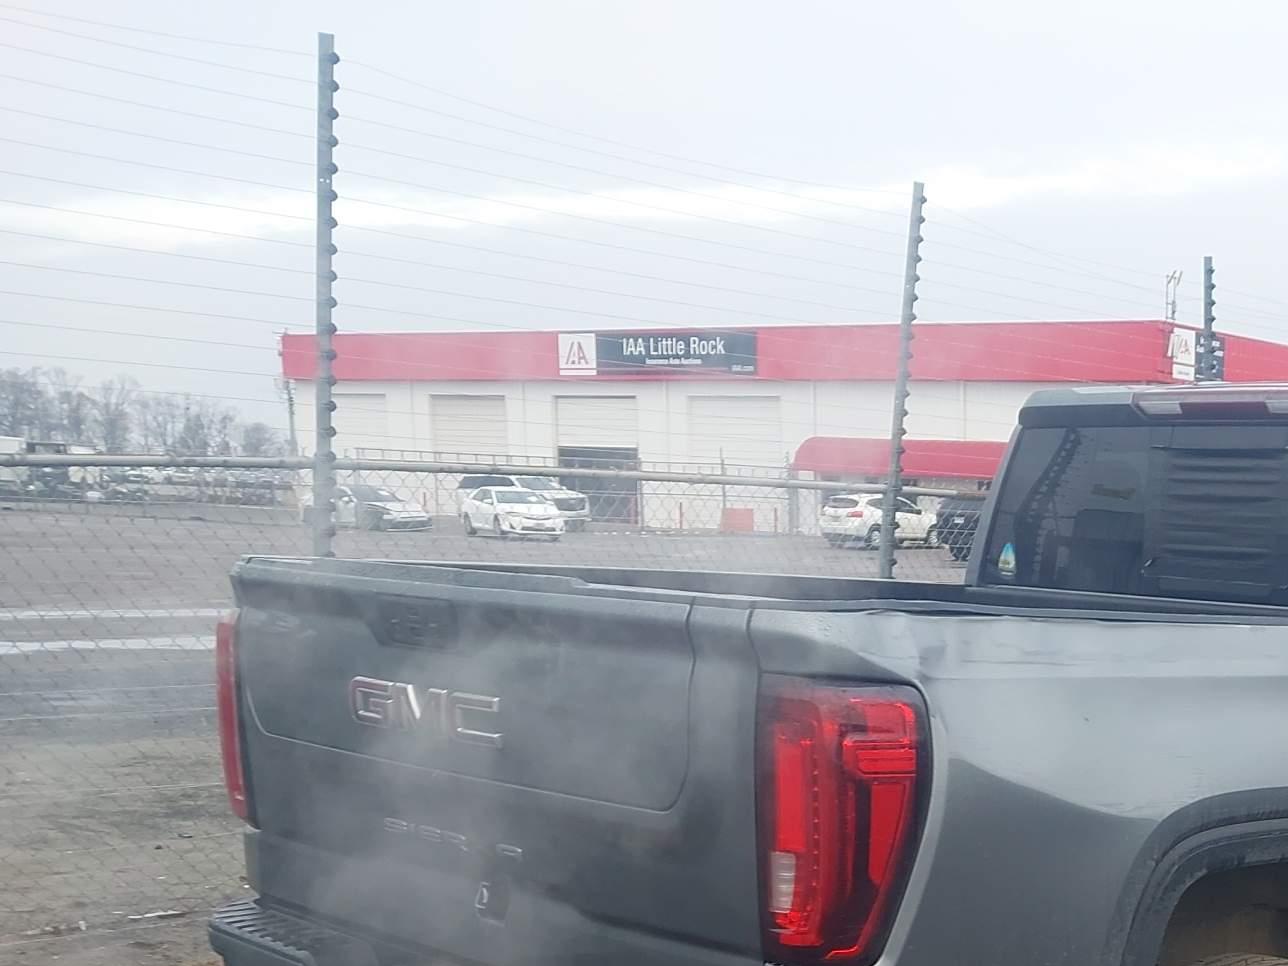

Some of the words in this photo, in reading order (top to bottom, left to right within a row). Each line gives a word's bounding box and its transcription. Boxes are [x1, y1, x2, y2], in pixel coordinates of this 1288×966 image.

[622, 338, 645, 355] IAA
[649, 337, 685, 355] Little
[689, 336, 726, 355] Rock
[349, 675, 503, 749] GMC
